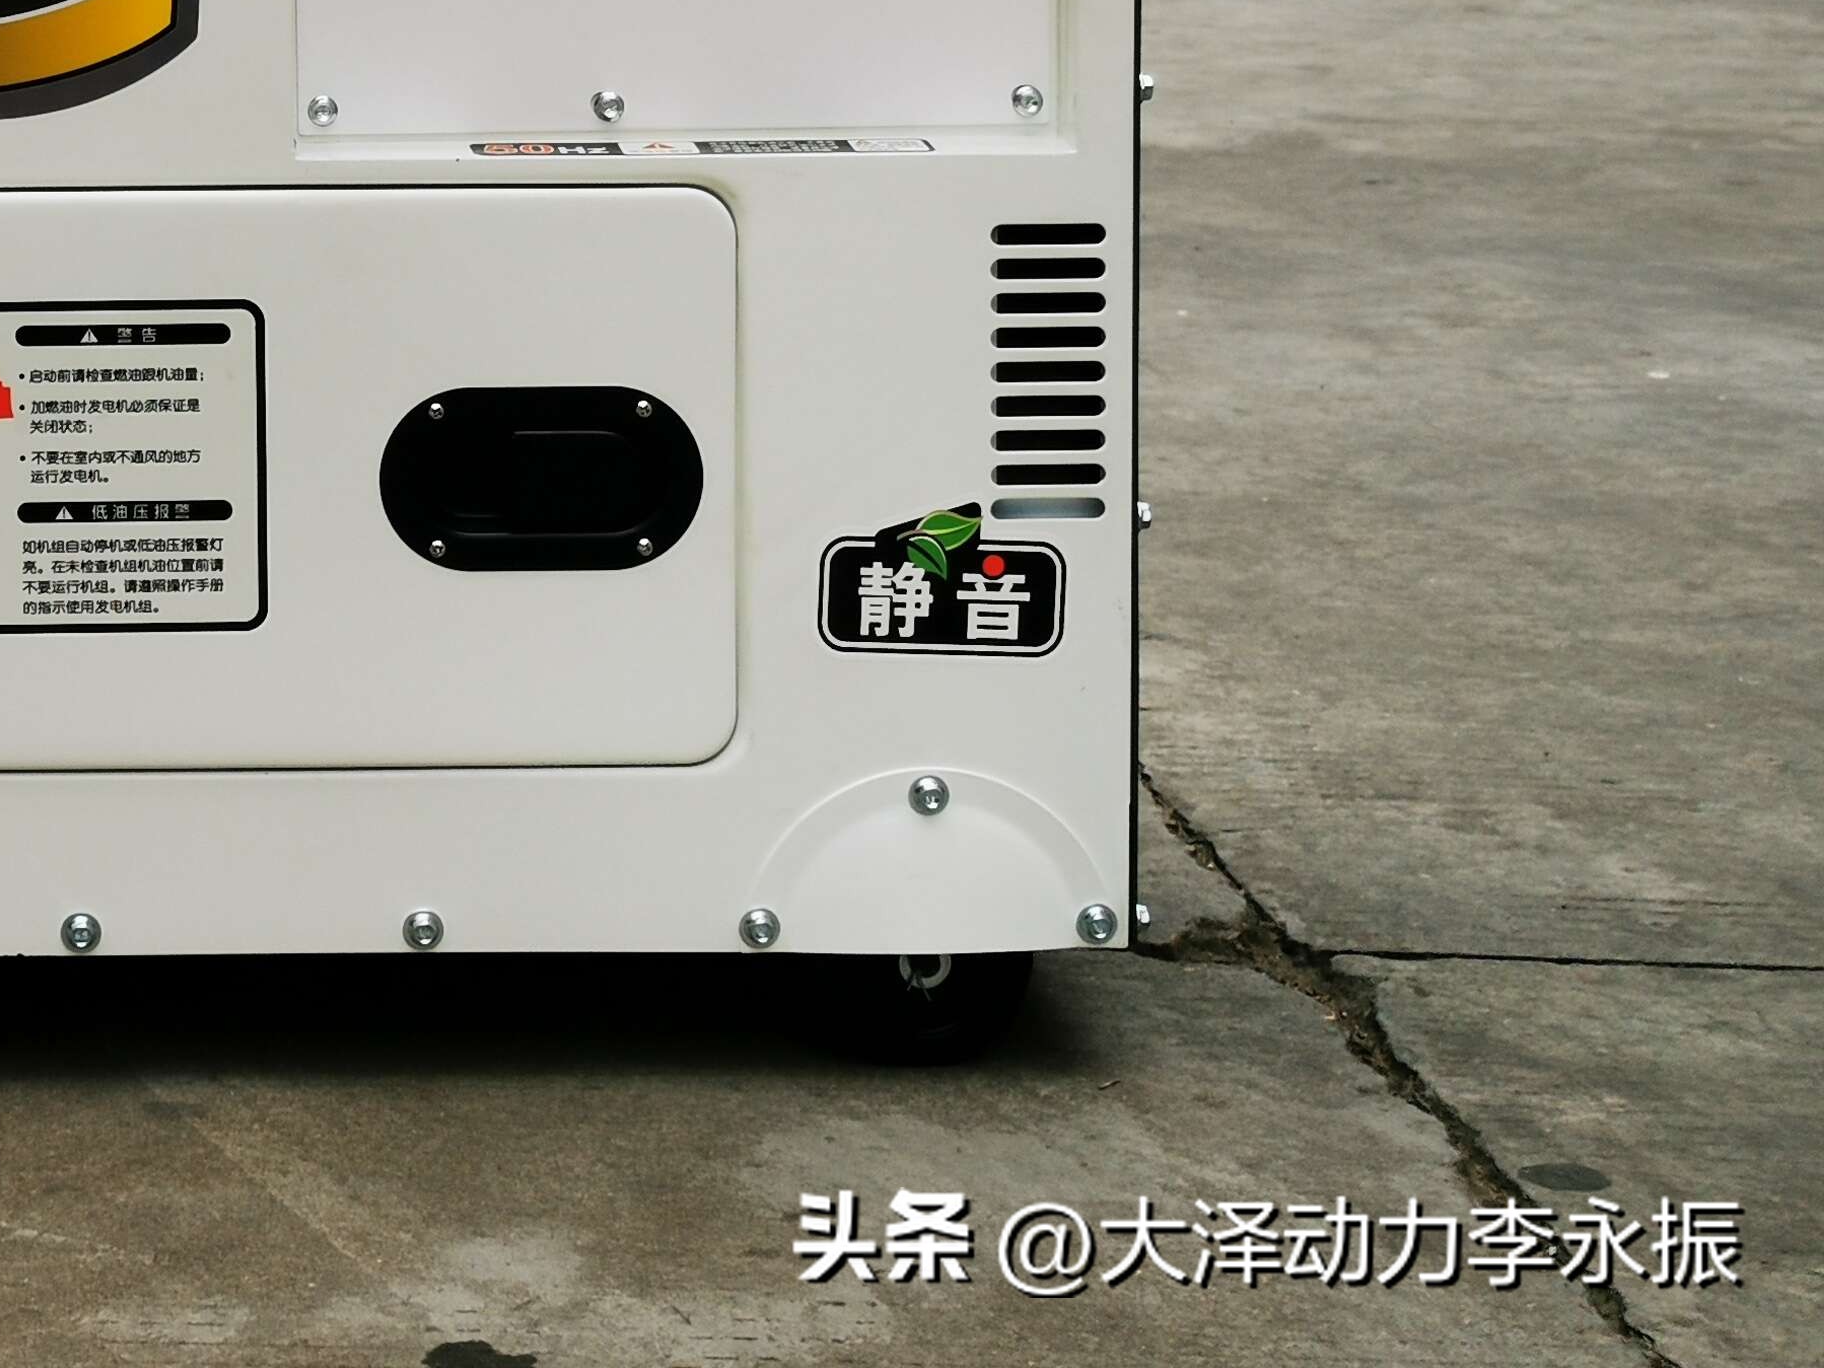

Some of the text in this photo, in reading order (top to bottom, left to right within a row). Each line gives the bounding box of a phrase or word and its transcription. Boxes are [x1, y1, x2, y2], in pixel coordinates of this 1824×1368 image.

[117, 327, 157, 343] 警告
[30, 398, 201, 415] 加燃油时发电机必须保证是
[31, 448, 201, 466] 不要在室内或不通风的地方
[30, 468, 109, 485] 运行发电机。
[91, 503, 190, 520] 低油压报警
[22, 537, 224, 555] 如机组自动停机或低油压报警灯
[22, 599, 160, 616] 的指示使用发电机组。
[858, 561, 1031, 641] 静音
